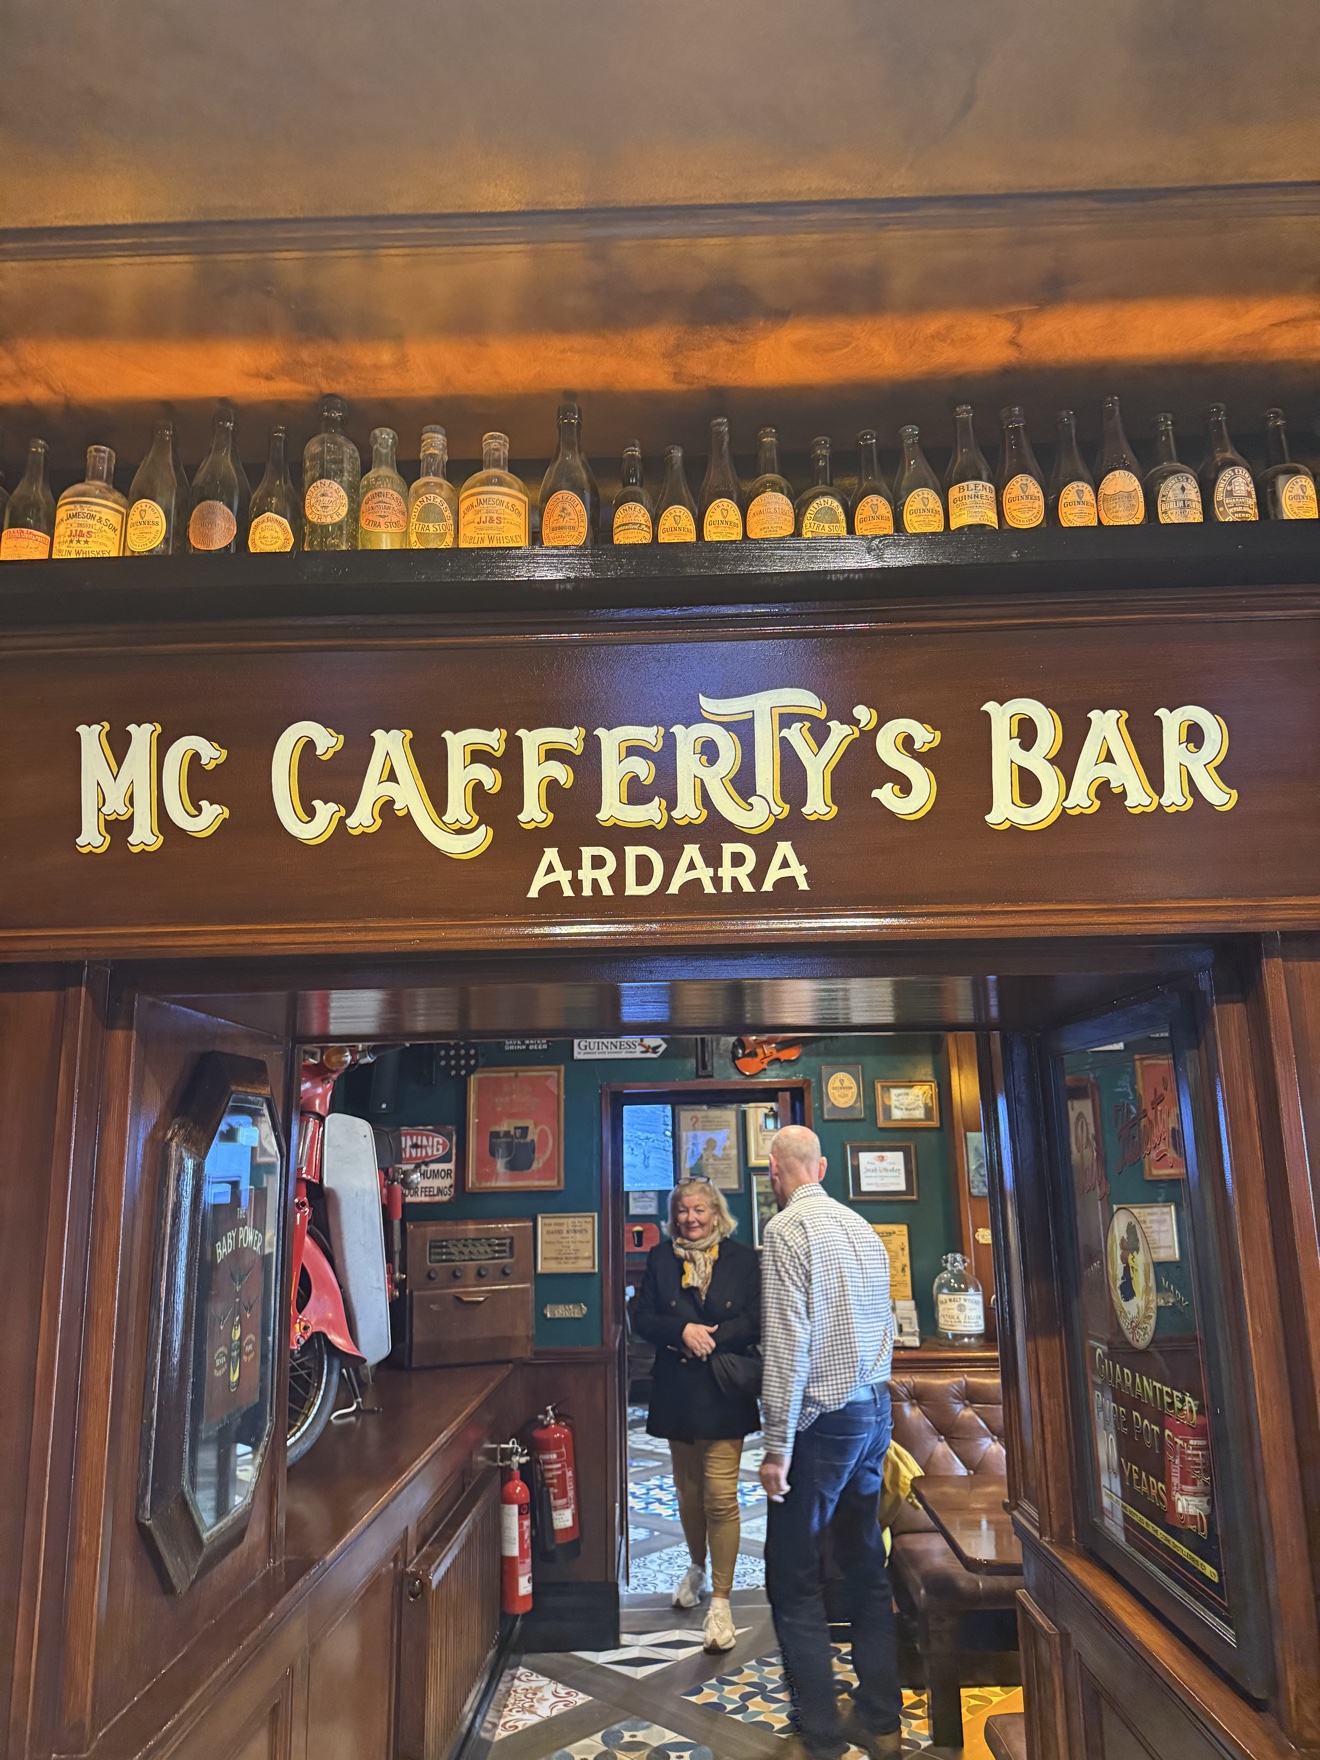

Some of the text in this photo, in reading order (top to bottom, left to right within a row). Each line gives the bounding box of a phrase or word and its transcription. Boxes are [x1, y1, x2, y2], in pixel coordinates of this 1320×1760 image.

[958, 483, 994, 494] BLEND
[474, 497, 505, 508] JAMESON
[1007, 495, 1041, 504] GUINNESS
[1063, 500, 1095, 508] GUINNESS
[65, 511, 97, 522] JAMESON
[97, 516, 103, 525] &
[309, 511, 343, 522] PORTER
[477, 515, 502, 525] JJ&S
[859, 514, 890, 524] GUINNESS
[130, 520, 160, 529] GUINNESS
[365, 519, 382, 529] EXTRA
[411, 523, 430, 532] EXTRA
[708, 520, 739, 529] GUINNESS
[804, 523, 826, 532] EXTRA
[67, 529, 93, 539] JJ&S
[661, 527, 693, 535] GUINNESS
[461, 533, 485, 544] DUBLIN
[487, 534, 523, 544] WHISKEY
[272, 687, 941, 859] CAFFERTY'S
[526, 841, 811, 898] ARDARA
[577, 1039, 638, 1051] GUINNESS
[420, 1168, 453, 1180] HUMOR
[420, 1186, 452, 1197] FEELINGS
[236, 1207, 247, 1220] THE
[215, 1225, 263, 1265] BABY POWER
[1095, 1347, 1197, 1428] GUARANTEED
[1094, 1390, 1128, 1435] PURE
[1132, 1410, 1161, 1454] POT
[1120, 1457, 1168, 1512] YEARS
[1174, 1491, 1208, 1540] OLD
